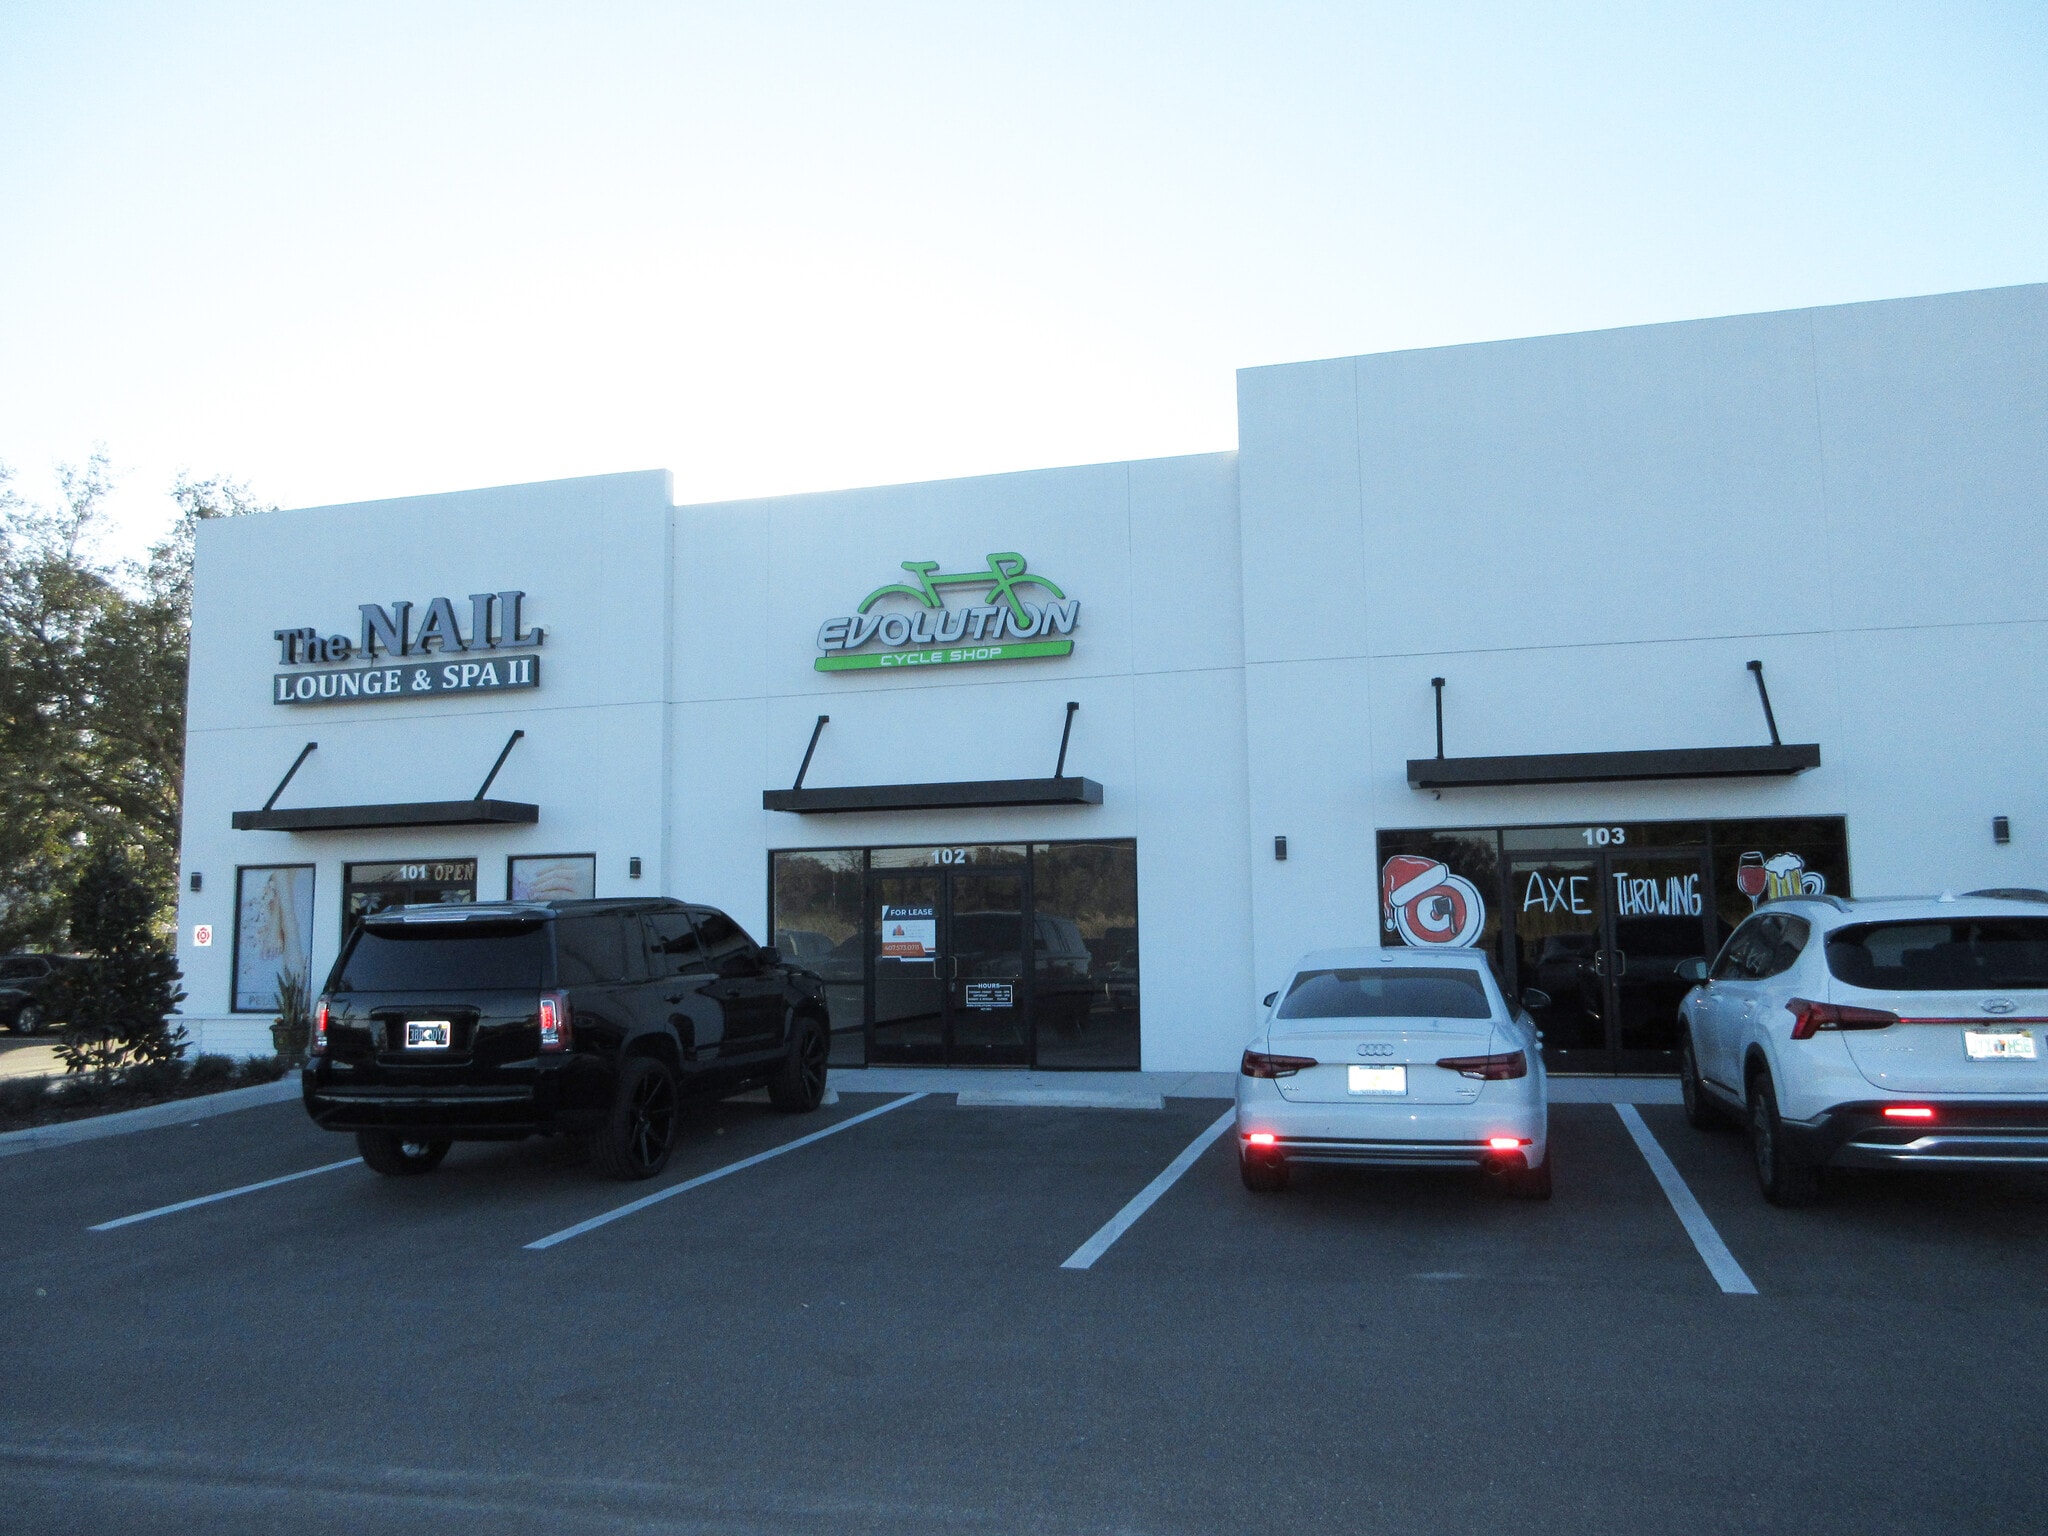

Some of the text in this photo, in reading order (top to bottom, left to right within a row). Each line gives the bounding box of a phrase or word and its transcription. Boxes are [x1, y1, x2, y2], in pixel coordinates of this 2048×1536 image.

[274, 590, 544, 665] The NAIL
[816, 599, 1081, 651] EVOLUTION
[880, 647, 1002, 667] CYCLE SHOP
[278, 658, 531, 701] LOUNGE & SPA II
[1582, 827, 1626, 846] 103
[931, 848, 966, 865] 102
[400, 864, 426, 879] 101
[435, 862, 475, 881] OPEN
[1523, 871, 1703, 916] AXE THROWING
[890, 908, 933, 917] FOR LEASE
